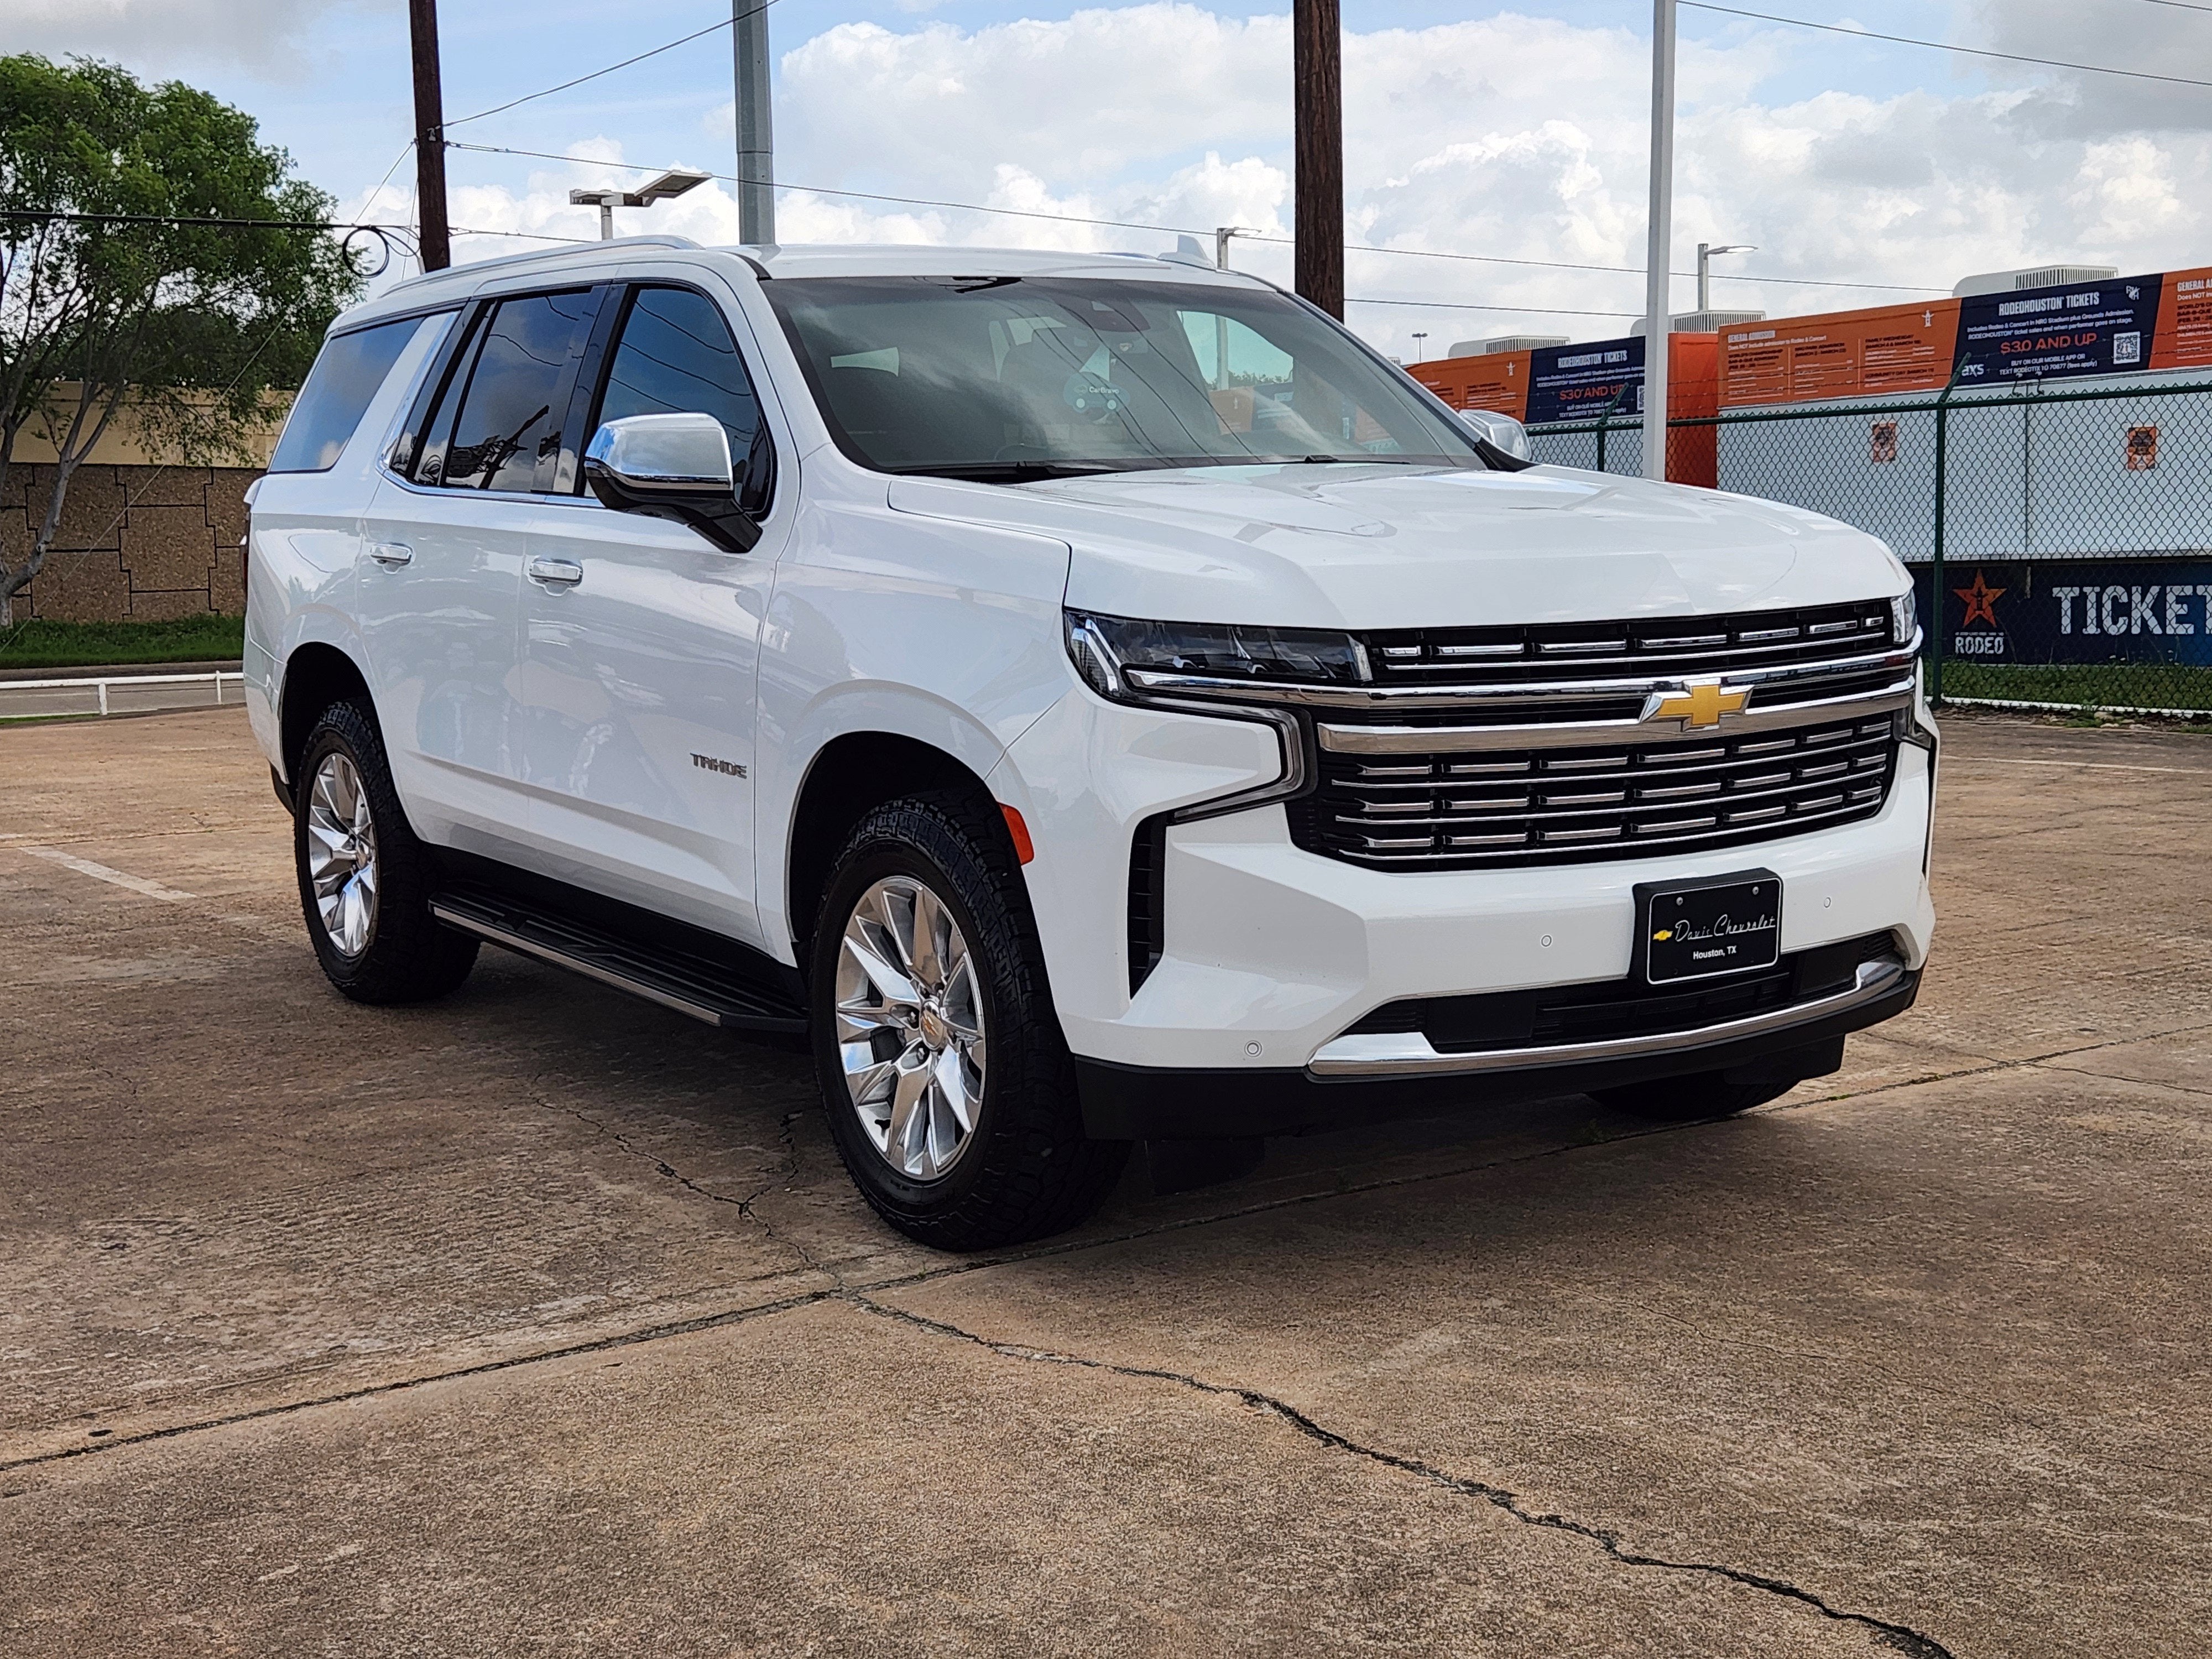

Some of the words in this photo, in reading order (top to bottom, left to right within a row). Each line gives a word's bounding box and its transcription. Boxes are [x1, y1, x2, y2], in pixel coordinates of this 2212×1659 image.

[2065, 291, 2100, 309] TICKETS
[2035, 336, 2071, 351] AND
[2075, 333, 2097, 347] UP
[1583, 386, 1609, 398] AND
[1955, 637, 2004, 654] RODEO
[690, 753, 747, 779] TAHOE
[1675, 920, 1713, 942] Davis
[1714, 914, 1776, 936] Chevrolet
[1693, 949, 1725, 960] Houston,
[1726, 945, 1737, 954] TX
